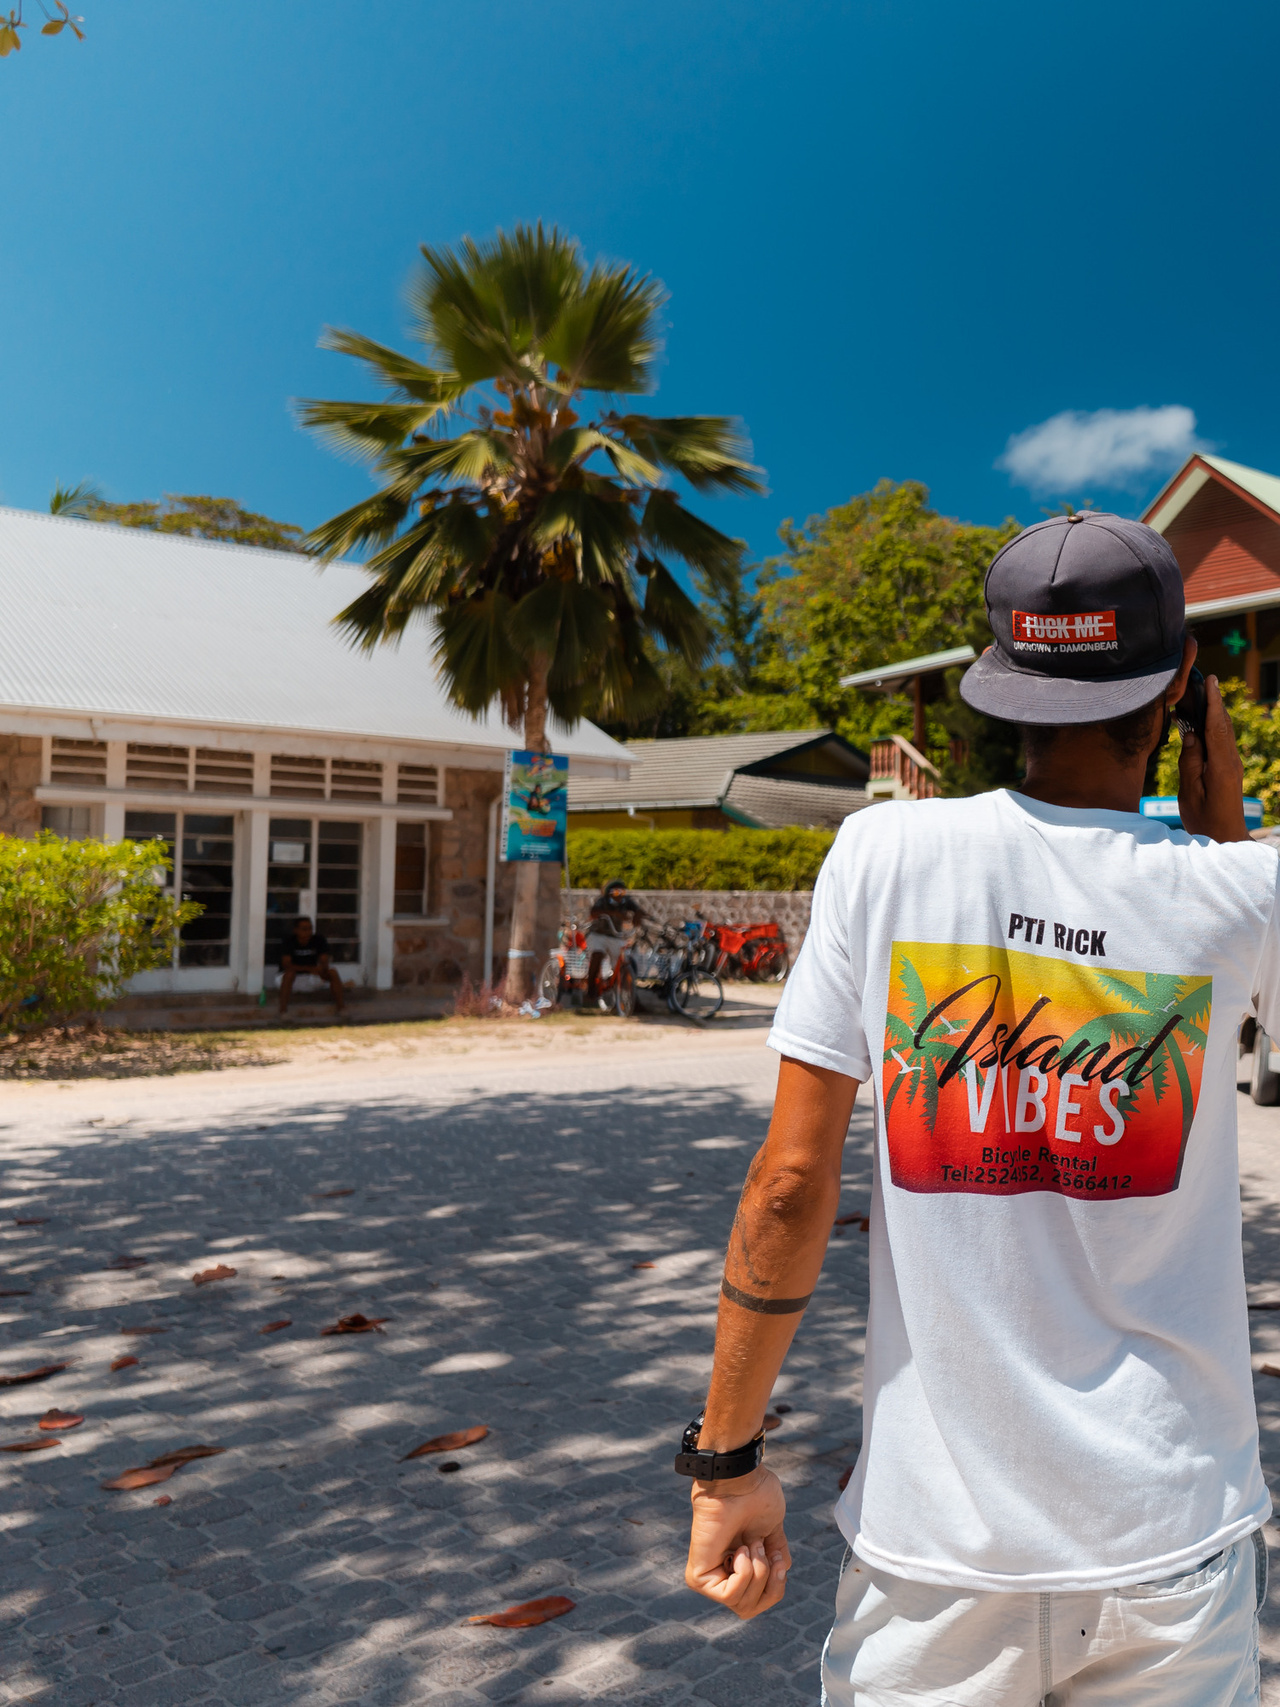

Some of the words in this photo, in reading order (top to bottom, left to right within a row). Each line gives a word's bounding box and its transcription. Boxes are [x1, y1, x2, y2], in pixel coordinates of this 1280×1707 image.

[1024, 615, 1071, 639] FUCK
[1074, 615, 1105, 638] ME
[1013, 641, 1051, 653] UNKNOWN
[1059, 641, 1118, 653] DAMONBEAR
[1008, 913, 1045, 945] PTI
[1054, 922, 1107, 957] RICK
[914, 974, 1184, 1089] Island
[966, 1059, 1130, 1146] VIBES
[1038, 1147, 1097, 1172] Rental
[1052, 1168, 1132, 1191] 2566412
